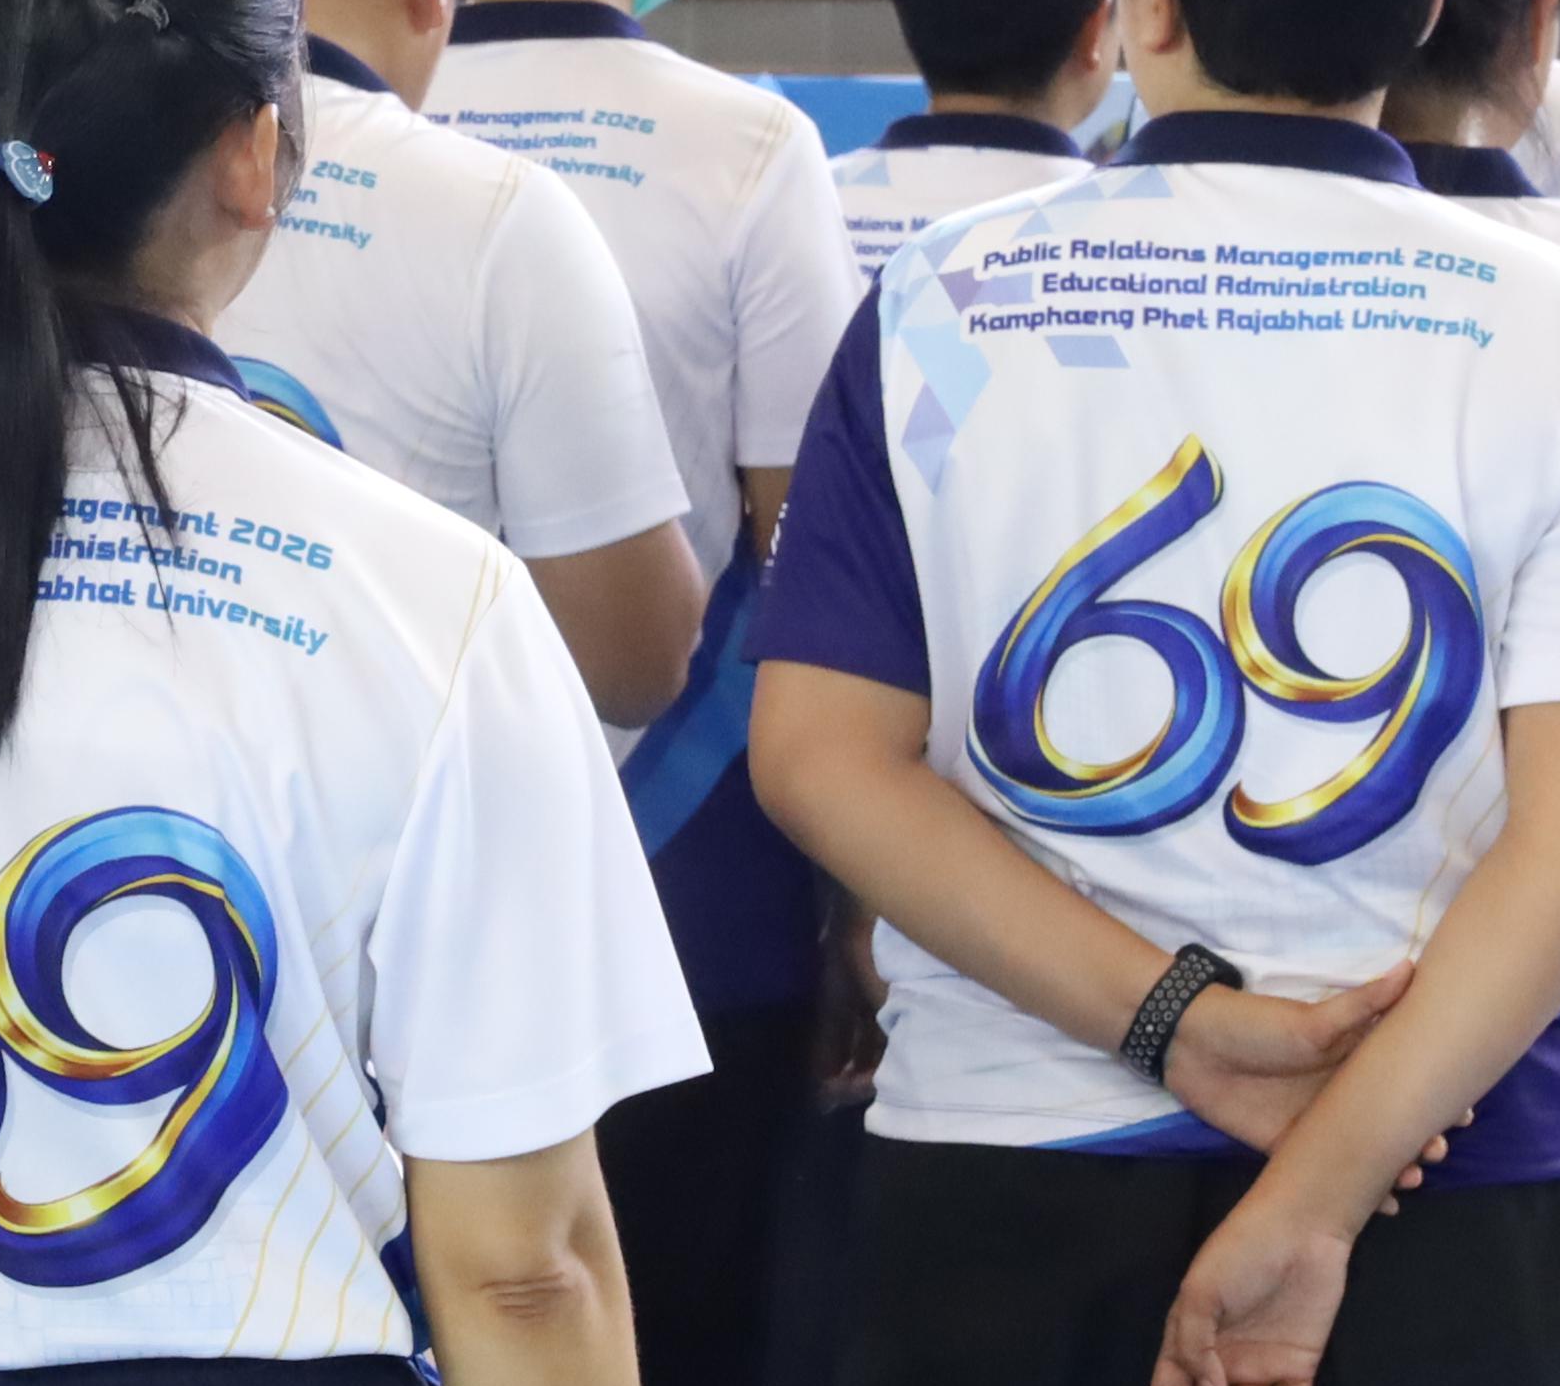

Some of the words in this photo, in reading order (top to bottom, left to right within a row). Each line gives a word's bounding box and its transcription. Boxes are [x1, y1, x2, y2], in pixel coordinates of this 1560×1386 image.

[456, 109, 586, 127] Management
[591, 110, 657, 135] 2026
[311, 161, 377, 189] 2026
[983, 242, 1061, 271] Public
[1070, 239, 1206, 263] Relations
[1215, 245, 1405, 271] Management
[1413, 248, 1498, 284] 2026
[1042, 271, 1208, 295] Educational
[1215, 274, 1427, 299] Administration
[969, 306, 1135, 335] Kamphaeng
[1143, 307, 1209, 329] Phet
[1216, 308, 1345, 335] Rajabhat
[1352, 308, 1495, 349] University
[229, 517, 335, 571] 2026
[34, 573, 137, 606] abhat
[146, 581, 330, 657] University
[966, 433, 1485, 867] 69
